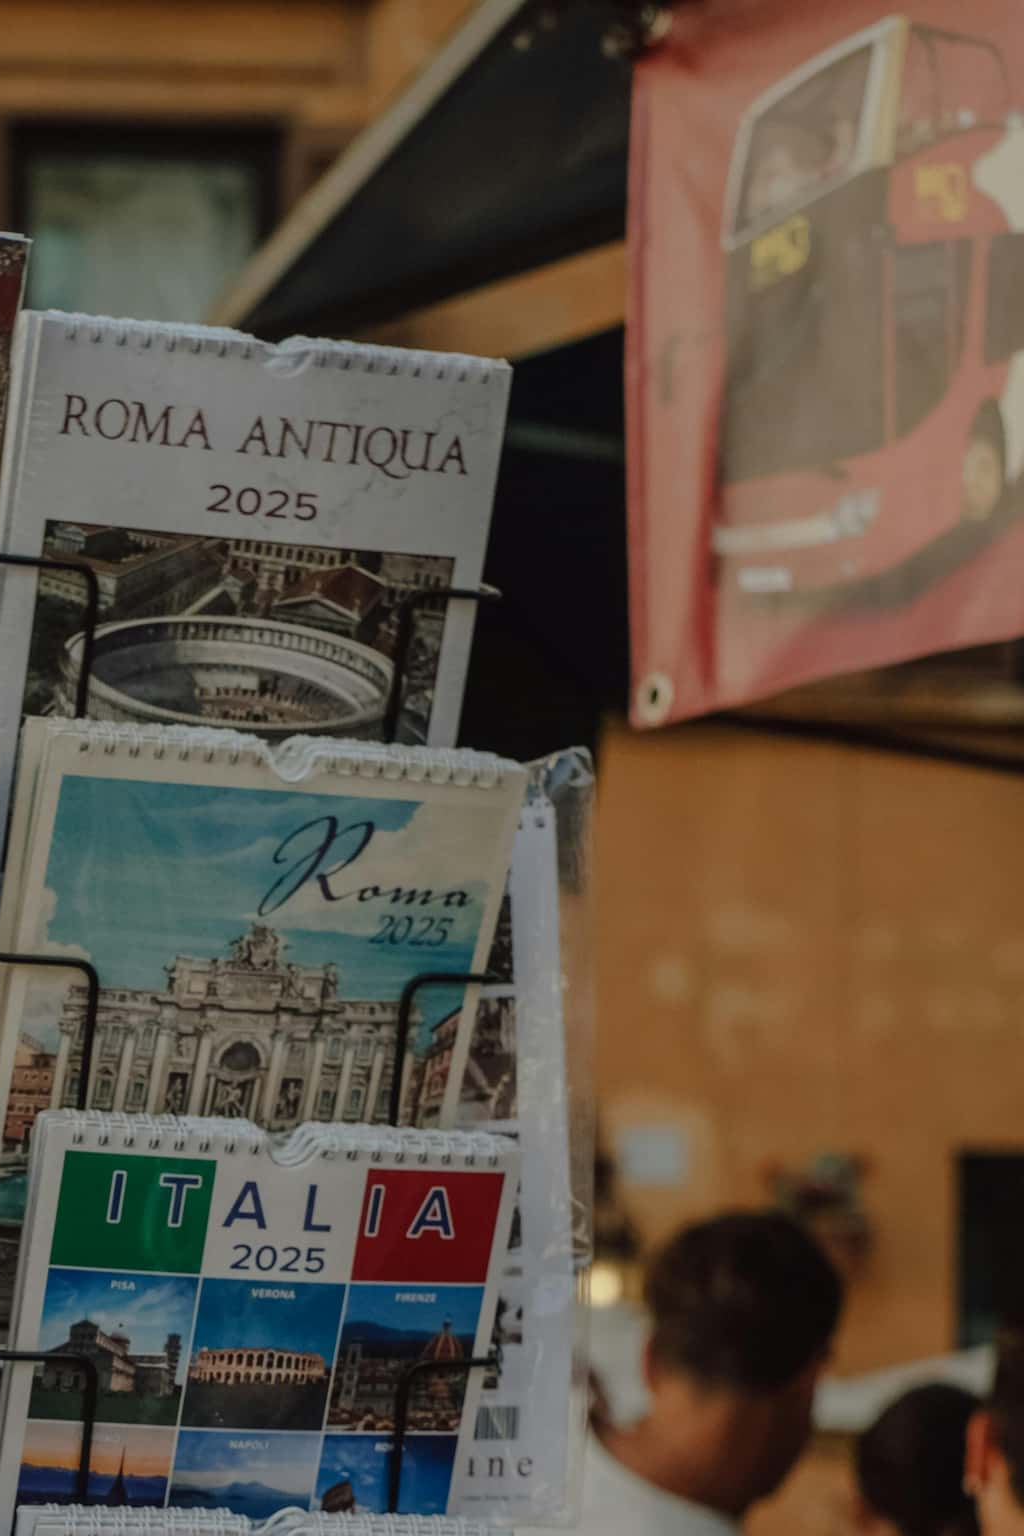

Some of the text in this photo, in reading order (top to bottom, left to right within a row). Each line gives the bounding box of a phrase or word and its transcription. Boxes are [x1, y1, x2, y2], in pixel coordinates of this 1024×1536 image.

[59, 395, 468, 479] ROMA ANTIQUA
[207, 484, 319, 521] 2025
[258, 815, 474, 917] Roma
[368, 914, 454, 947] 2025
[105, 1169, 456, 1240] ITALIA
[230, 1244, 326, 1274] 2025
[110, 1280, 136, 1292] PISA
[251, 1288, 296, 1300] VERONA
[394, 1292, 437, 1303] FIRENZE
[229, 1439, 270, 1450] NAPOLI
